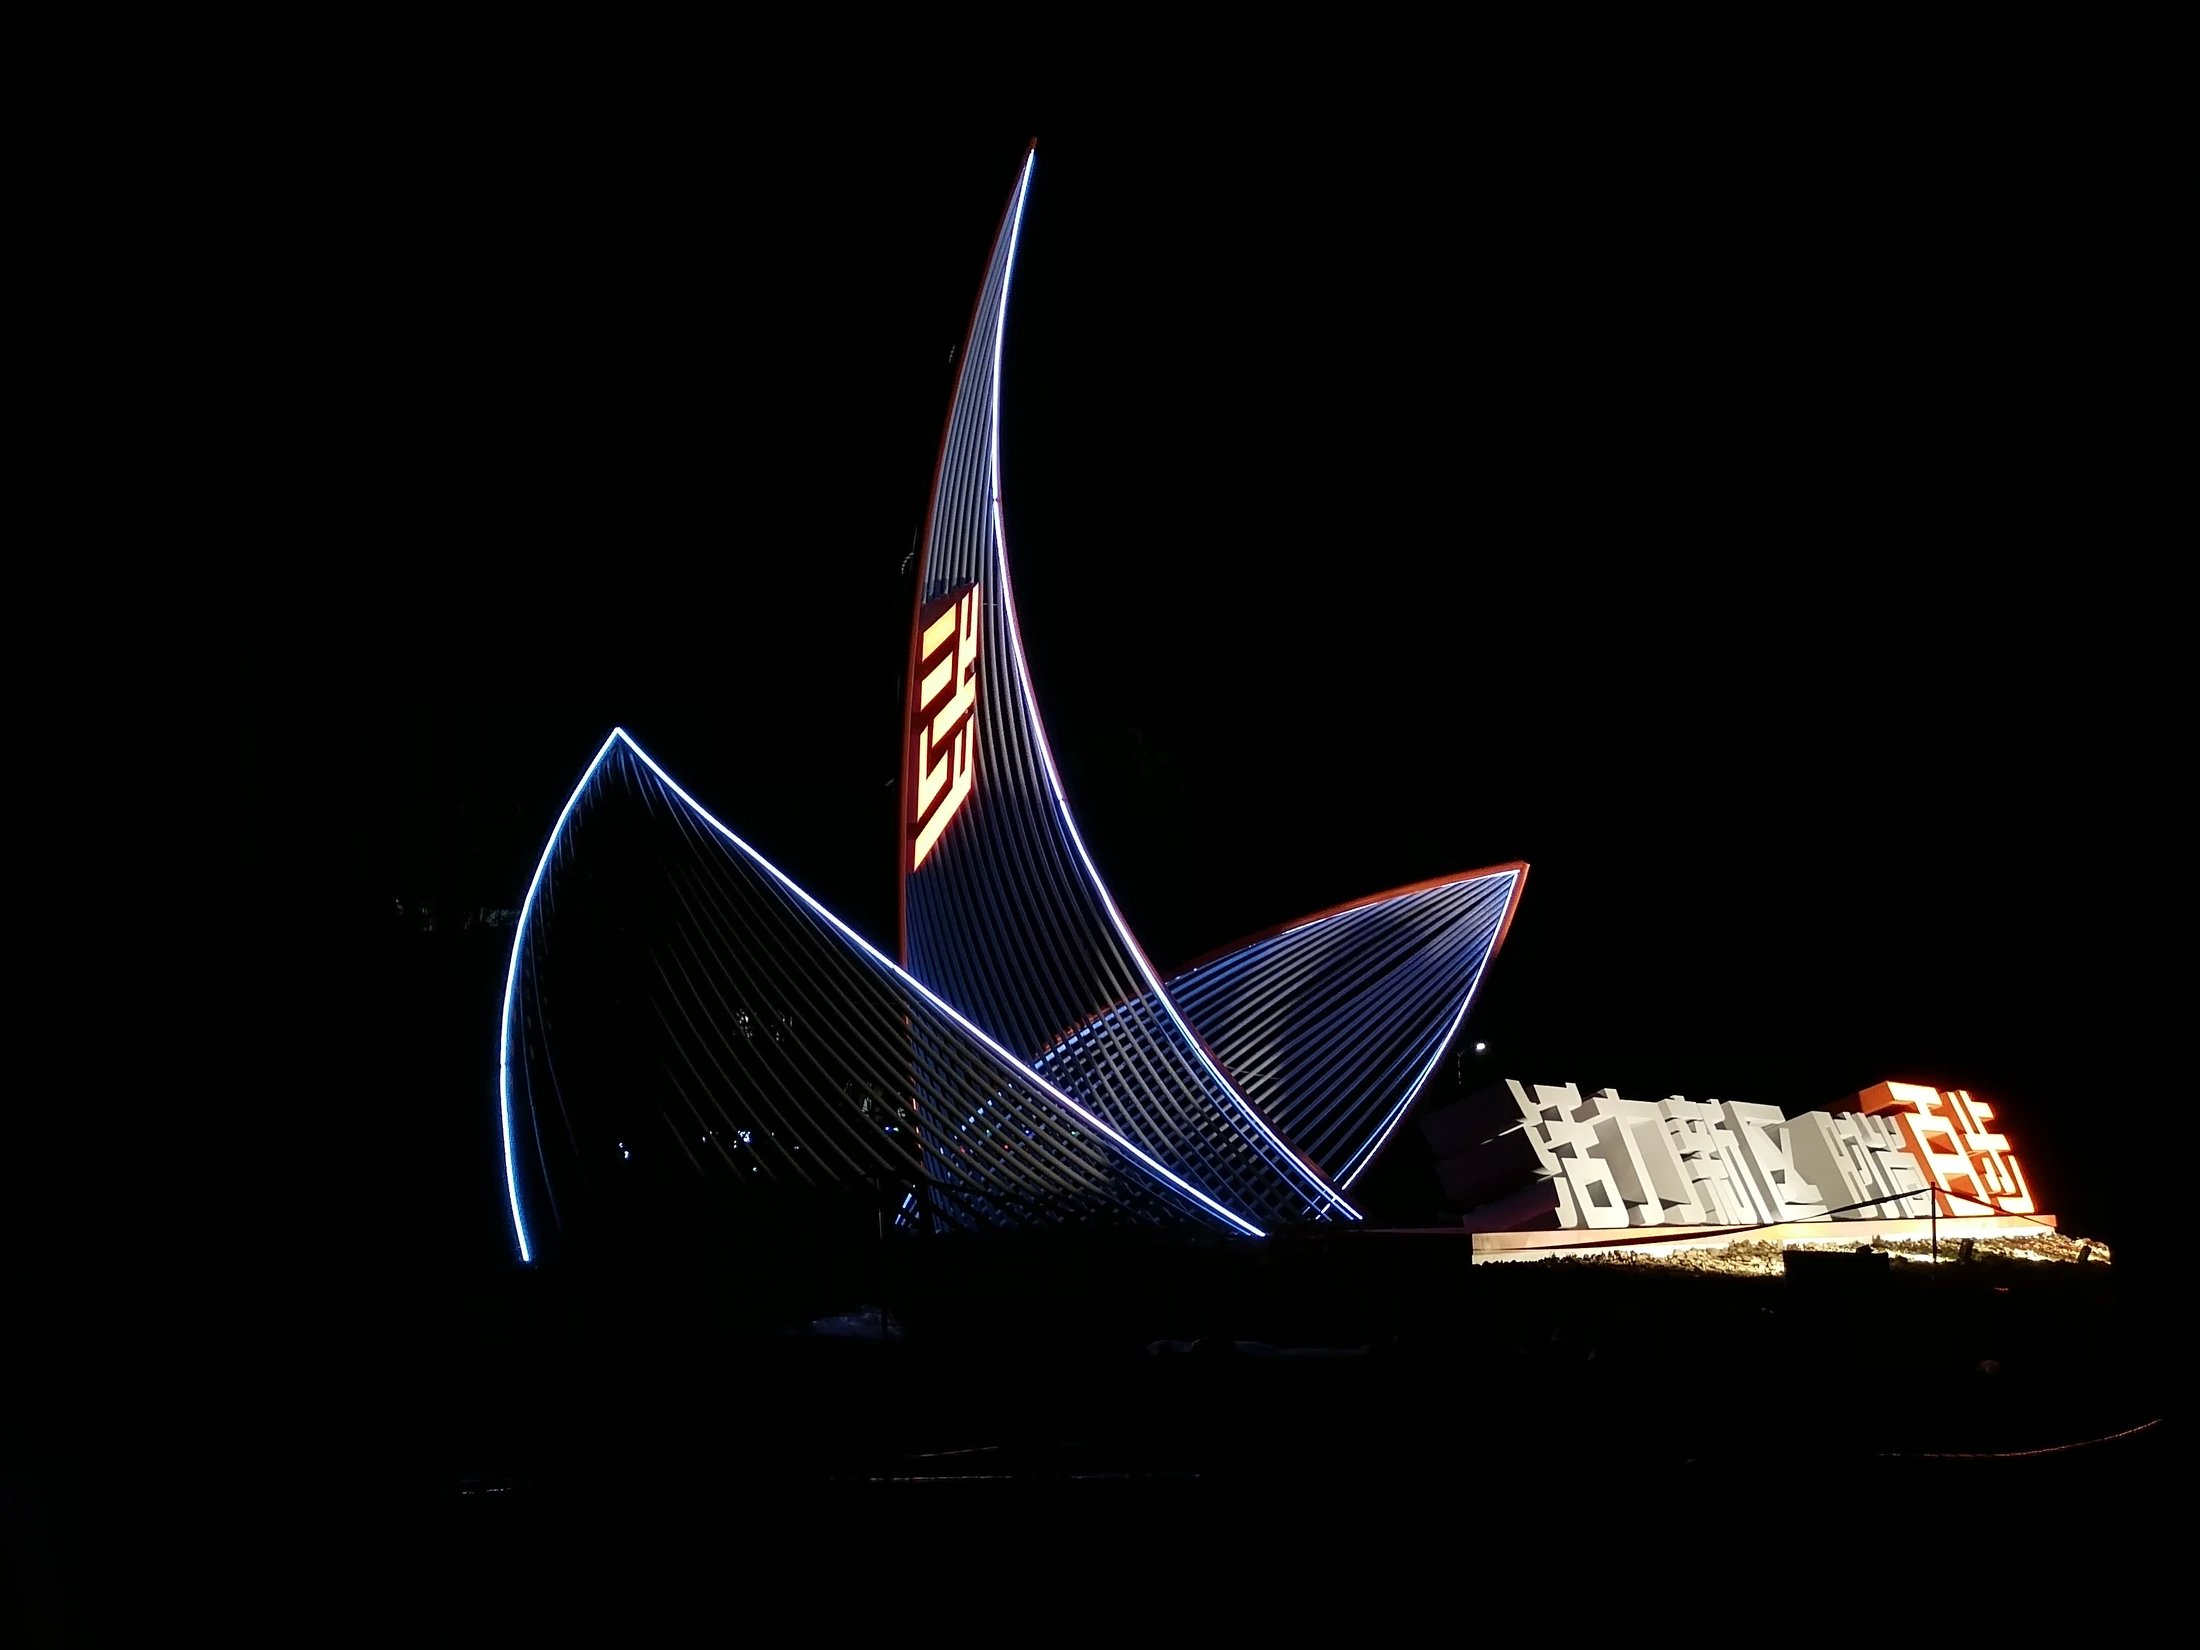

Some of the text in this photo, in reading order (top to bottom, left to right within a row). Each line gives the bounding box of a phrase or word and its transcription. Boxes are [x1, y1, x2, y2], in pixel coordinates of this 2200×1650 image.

[1505, 1078, 2035, 1229] 活力新区 时尚百步
